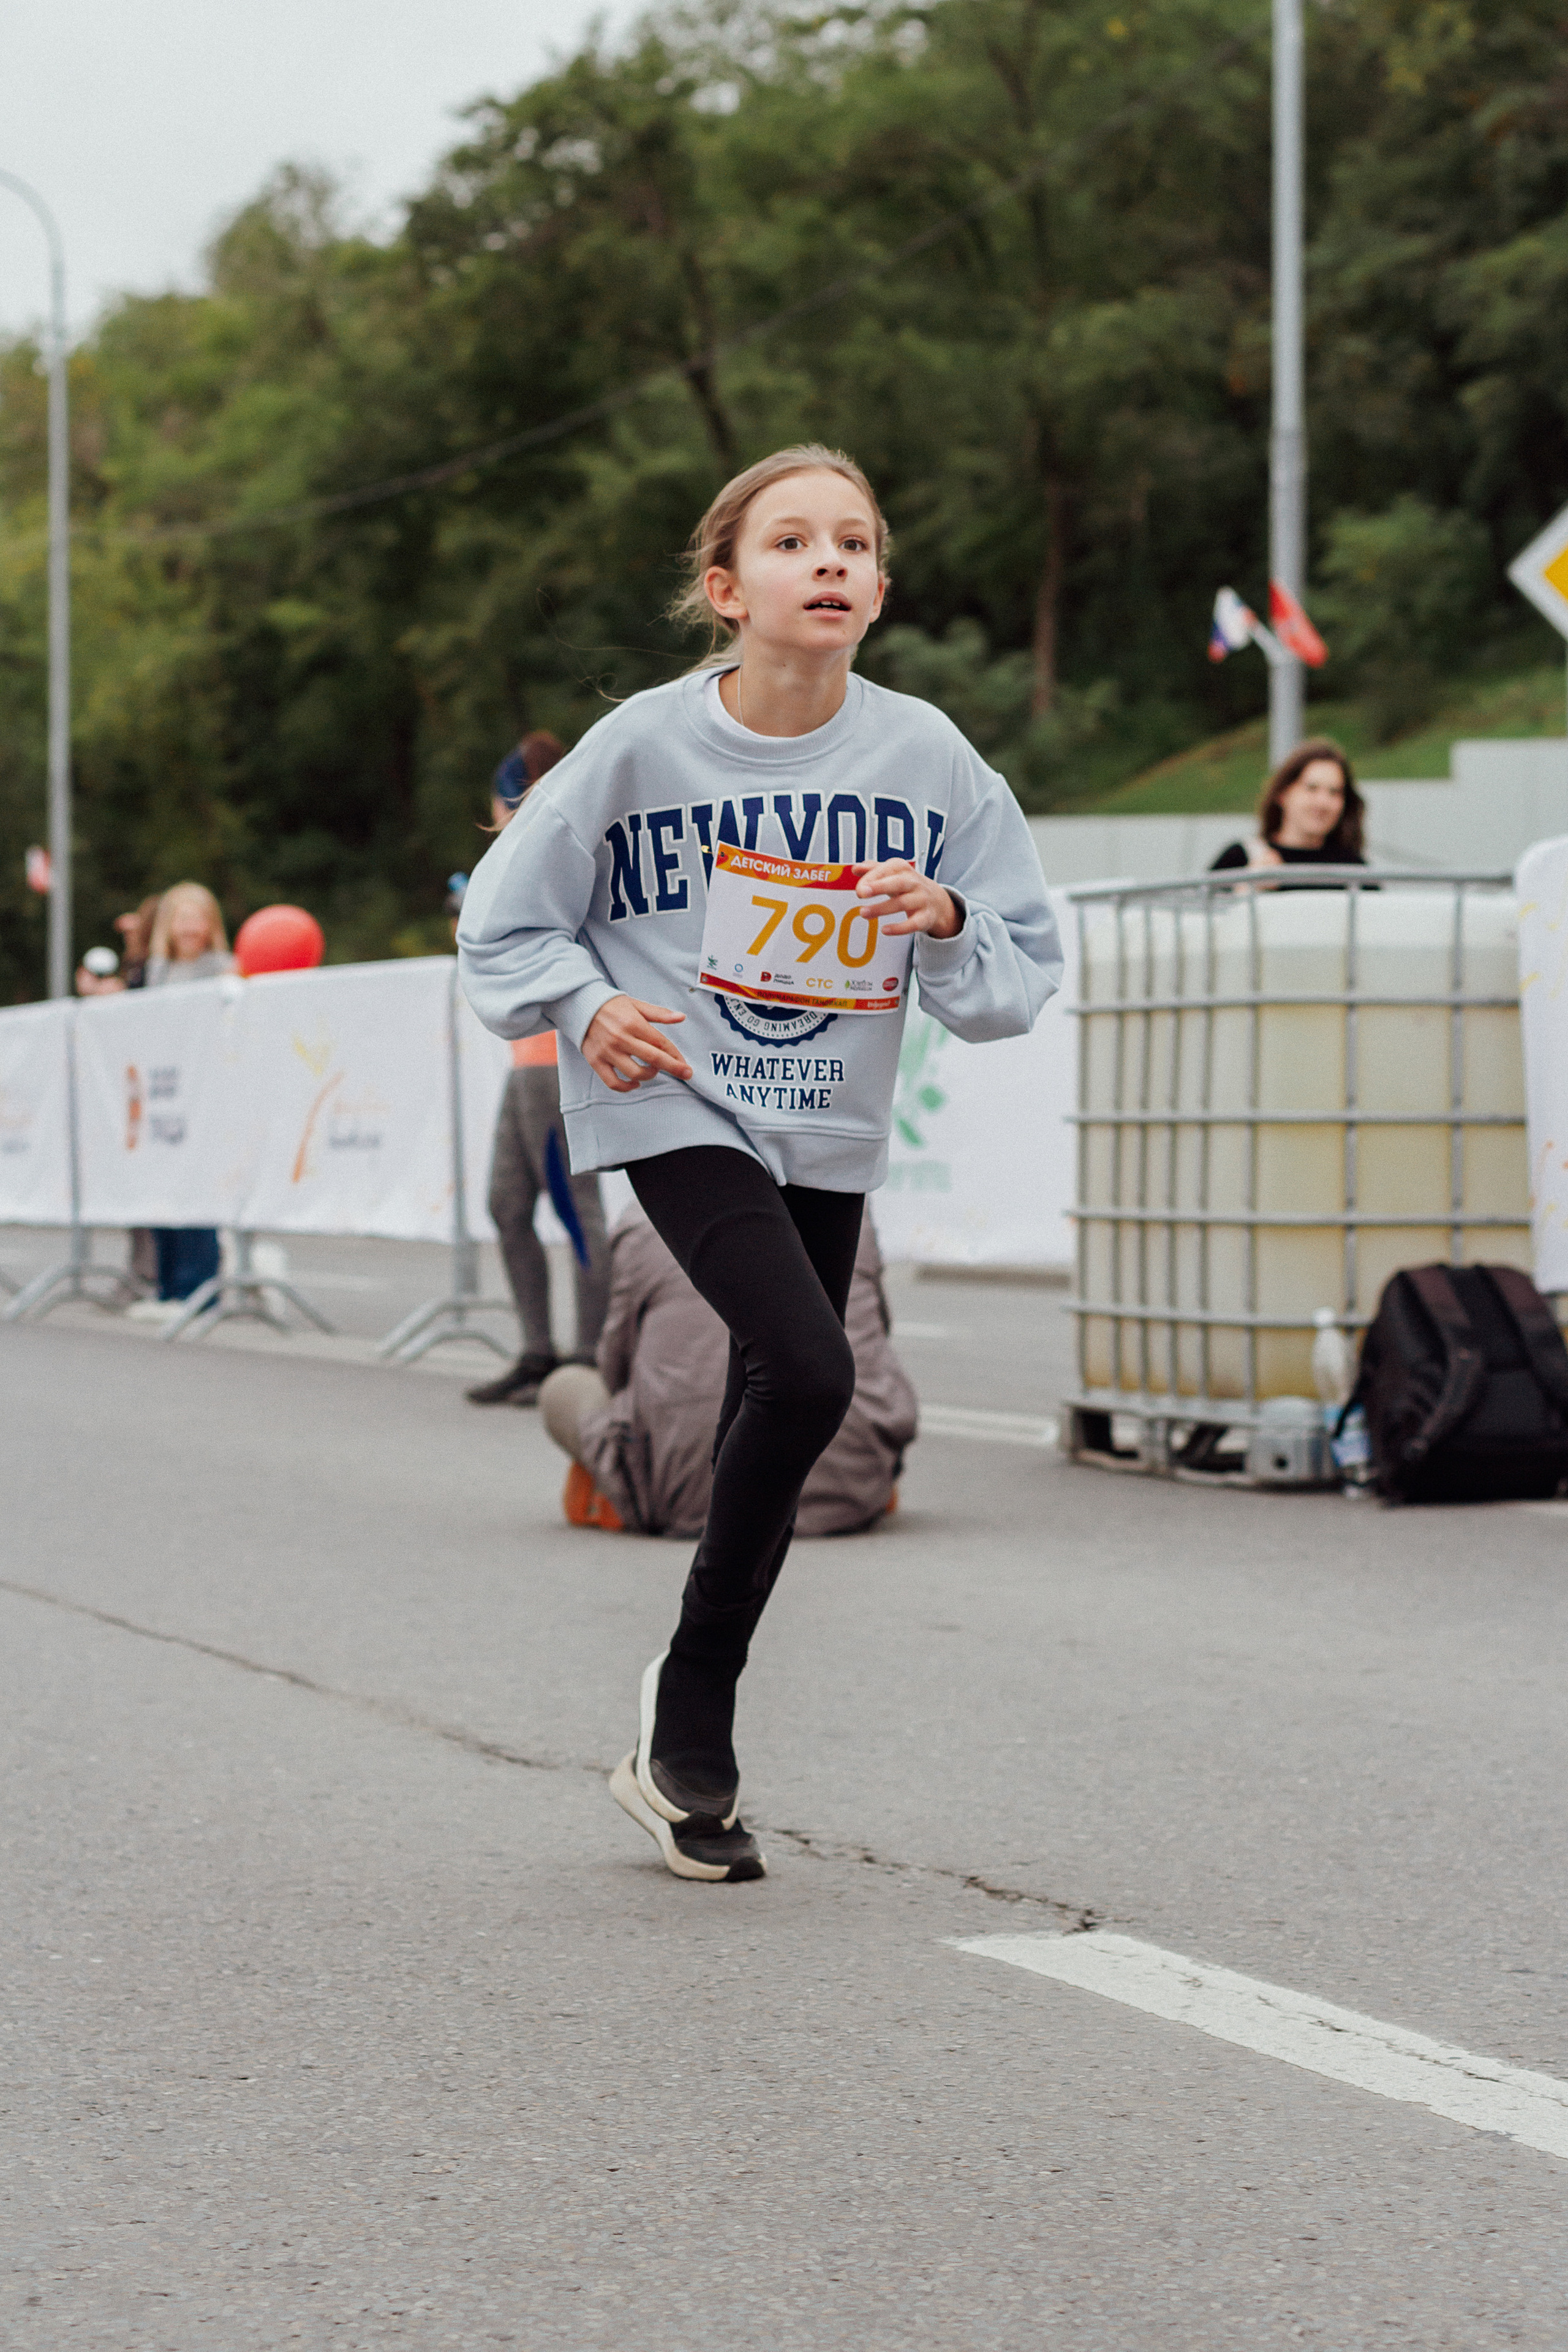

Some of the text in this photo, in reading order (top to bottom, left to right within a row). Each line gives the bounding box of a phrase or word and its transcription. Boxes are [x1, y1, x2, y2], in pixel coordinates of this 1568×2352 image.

[730, 854, 832, 881] ДЕТСКИЙ ЗАБЕГ
[745, 894, 879, 968] 790
[747, 1015, 760, 1027] GO
[764, 1011, 818, 1032] DREAMING
[710, 1052, 845, 1082] WHATEVER
[725, 1082, 832, 1110] ANYTIME
